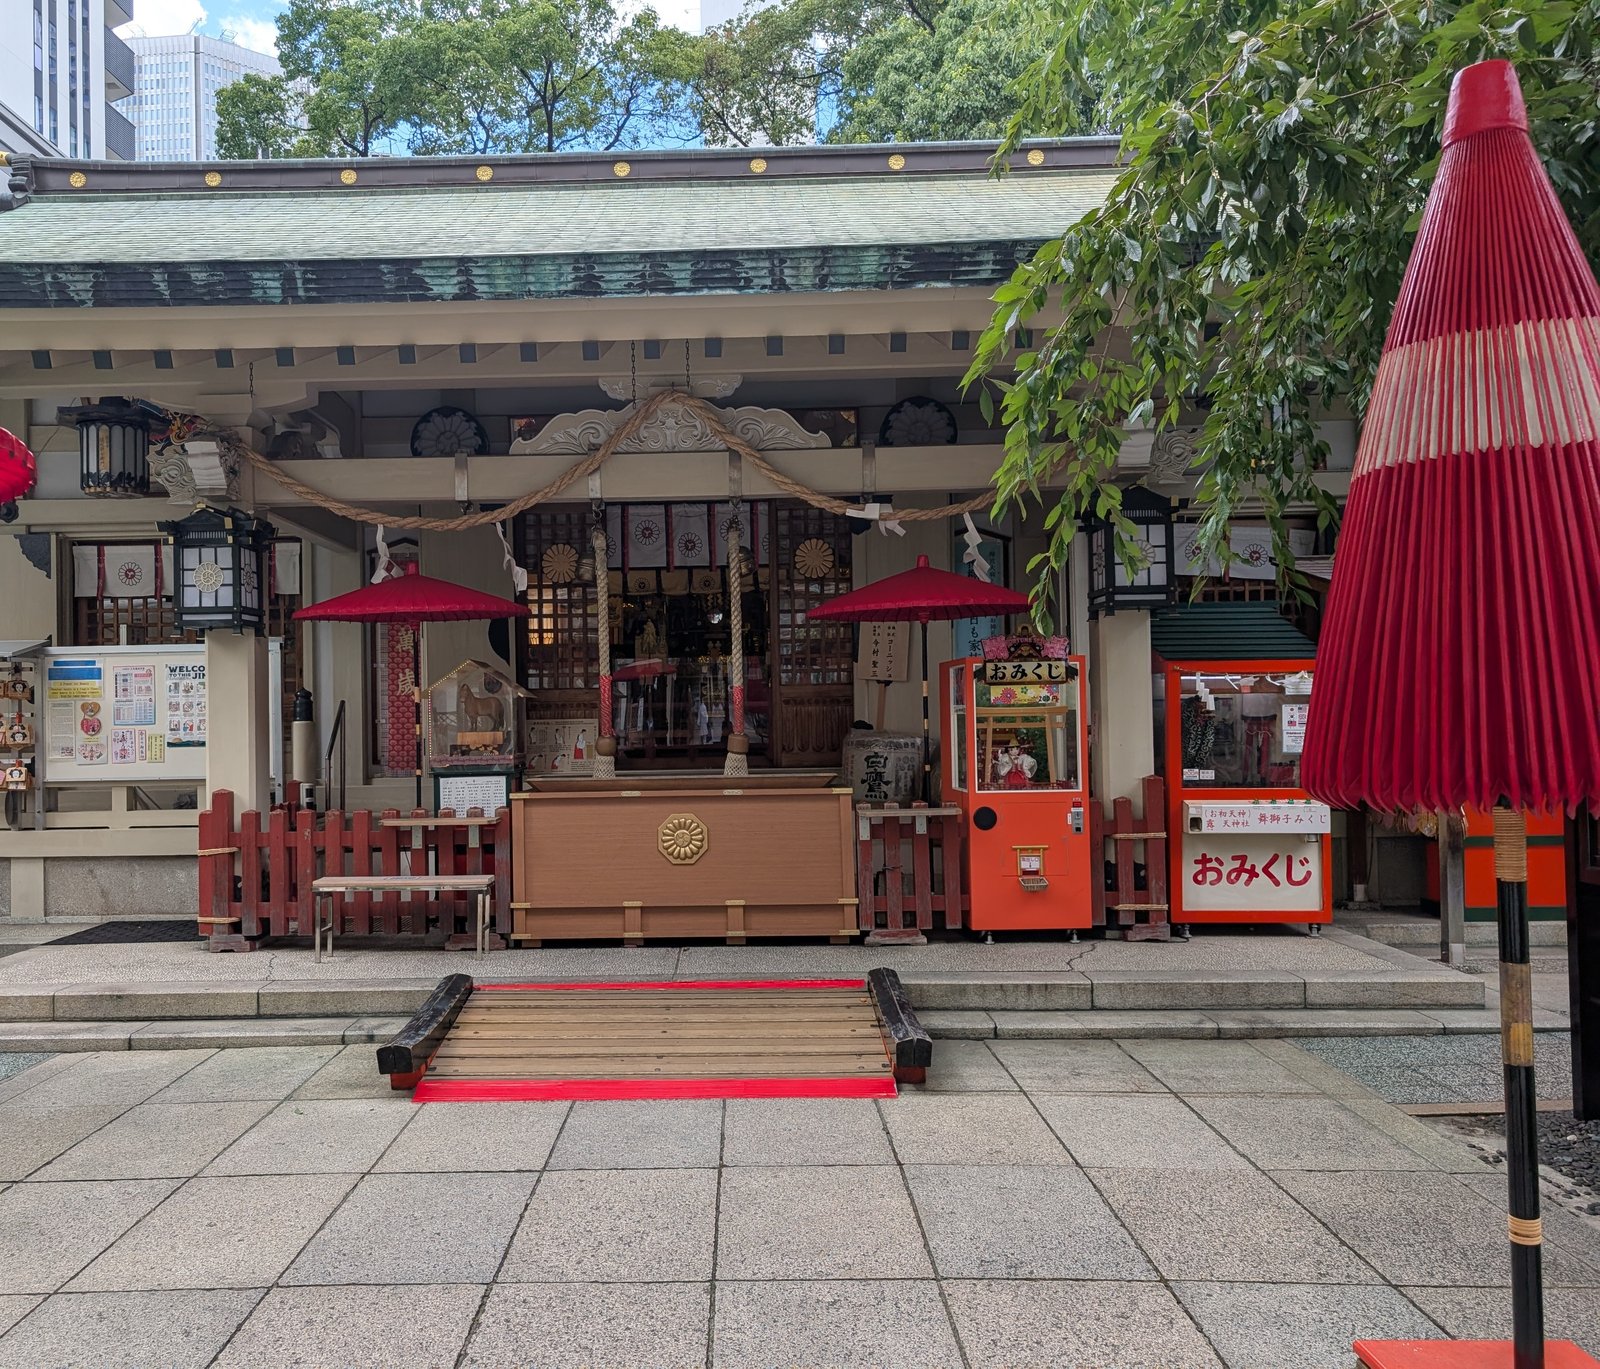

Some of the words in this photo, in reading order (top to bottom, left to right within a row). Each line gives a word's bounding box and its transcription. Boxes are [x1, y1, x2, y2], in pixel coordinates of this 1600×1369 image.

[990, 663, 1062, 680] おみくじ
[1192, 853, 1313, 887] おみくじ
